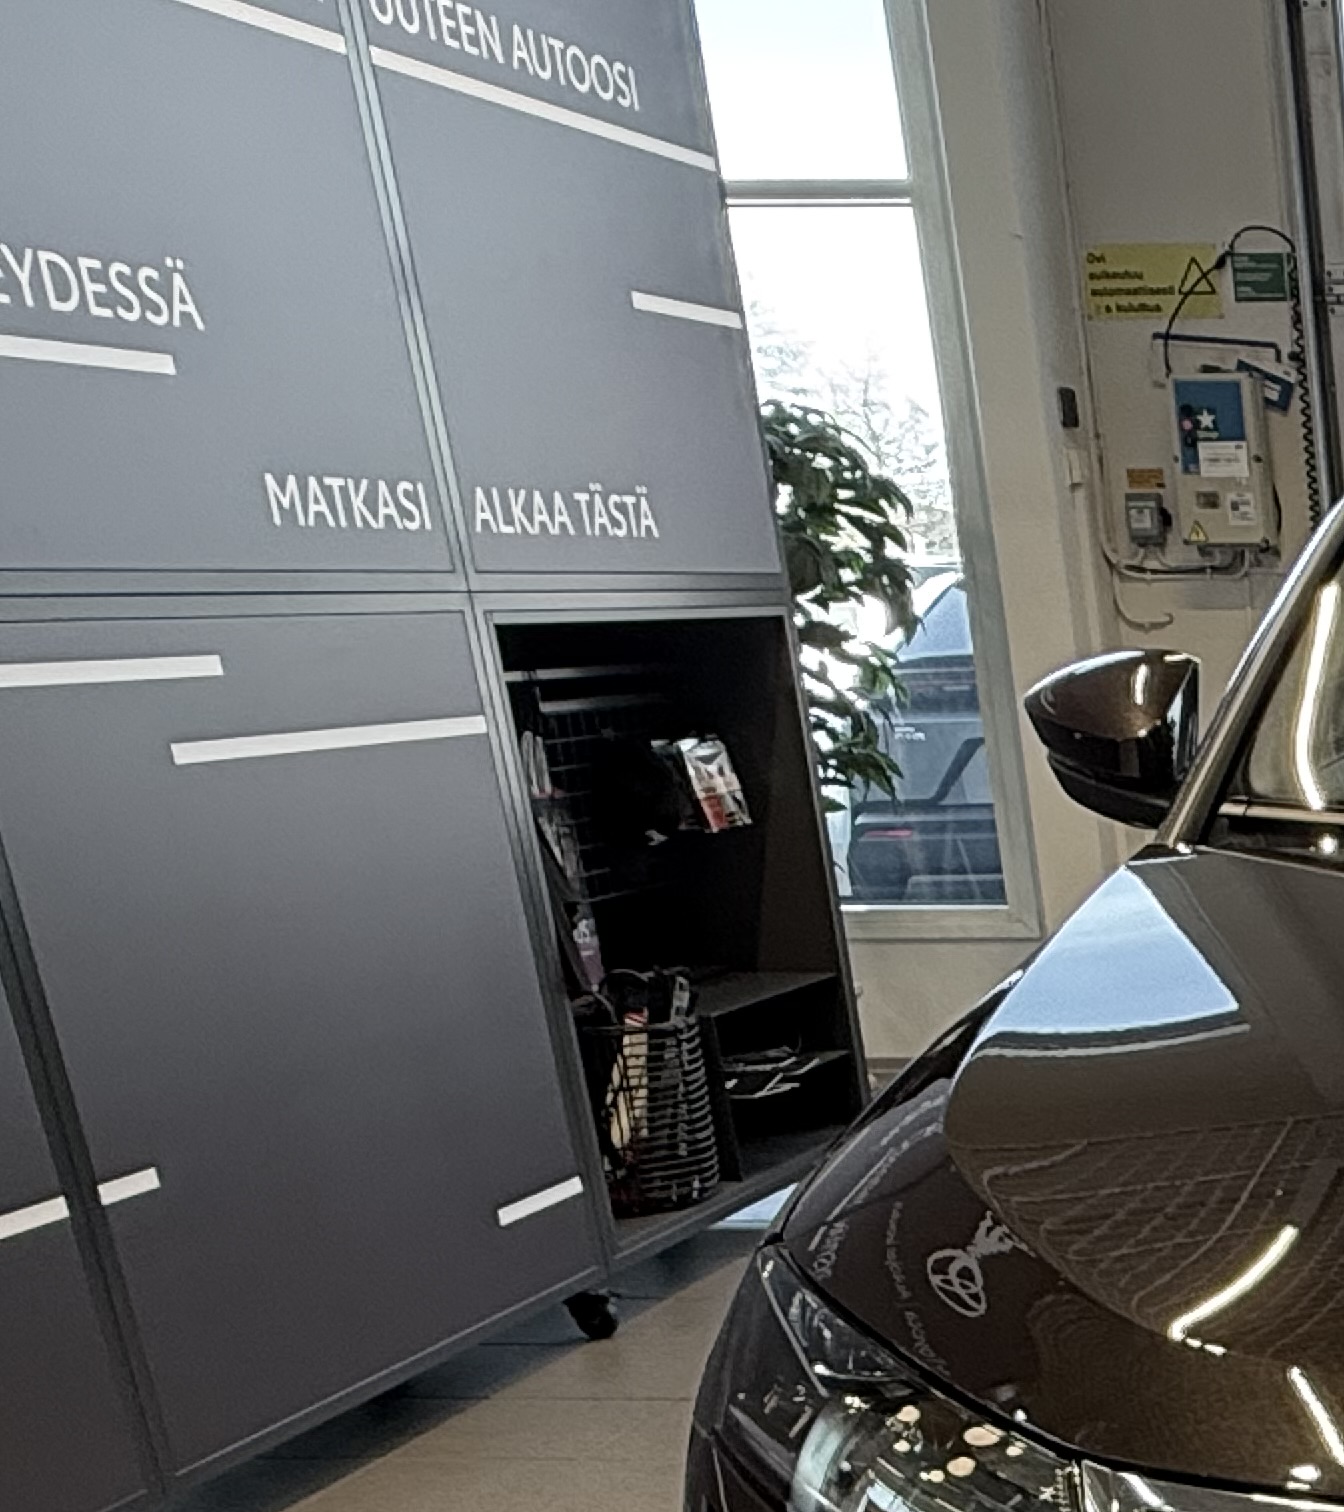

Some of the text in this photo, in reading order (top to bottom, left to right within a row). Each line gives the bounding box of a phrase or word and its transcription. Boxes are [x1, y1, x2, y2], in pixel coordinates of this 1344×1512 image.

[512, 24, 640, 111] AUTOOSI
[264, 472, 660, 538] MATKASI ALKAA TÄSTÄ
